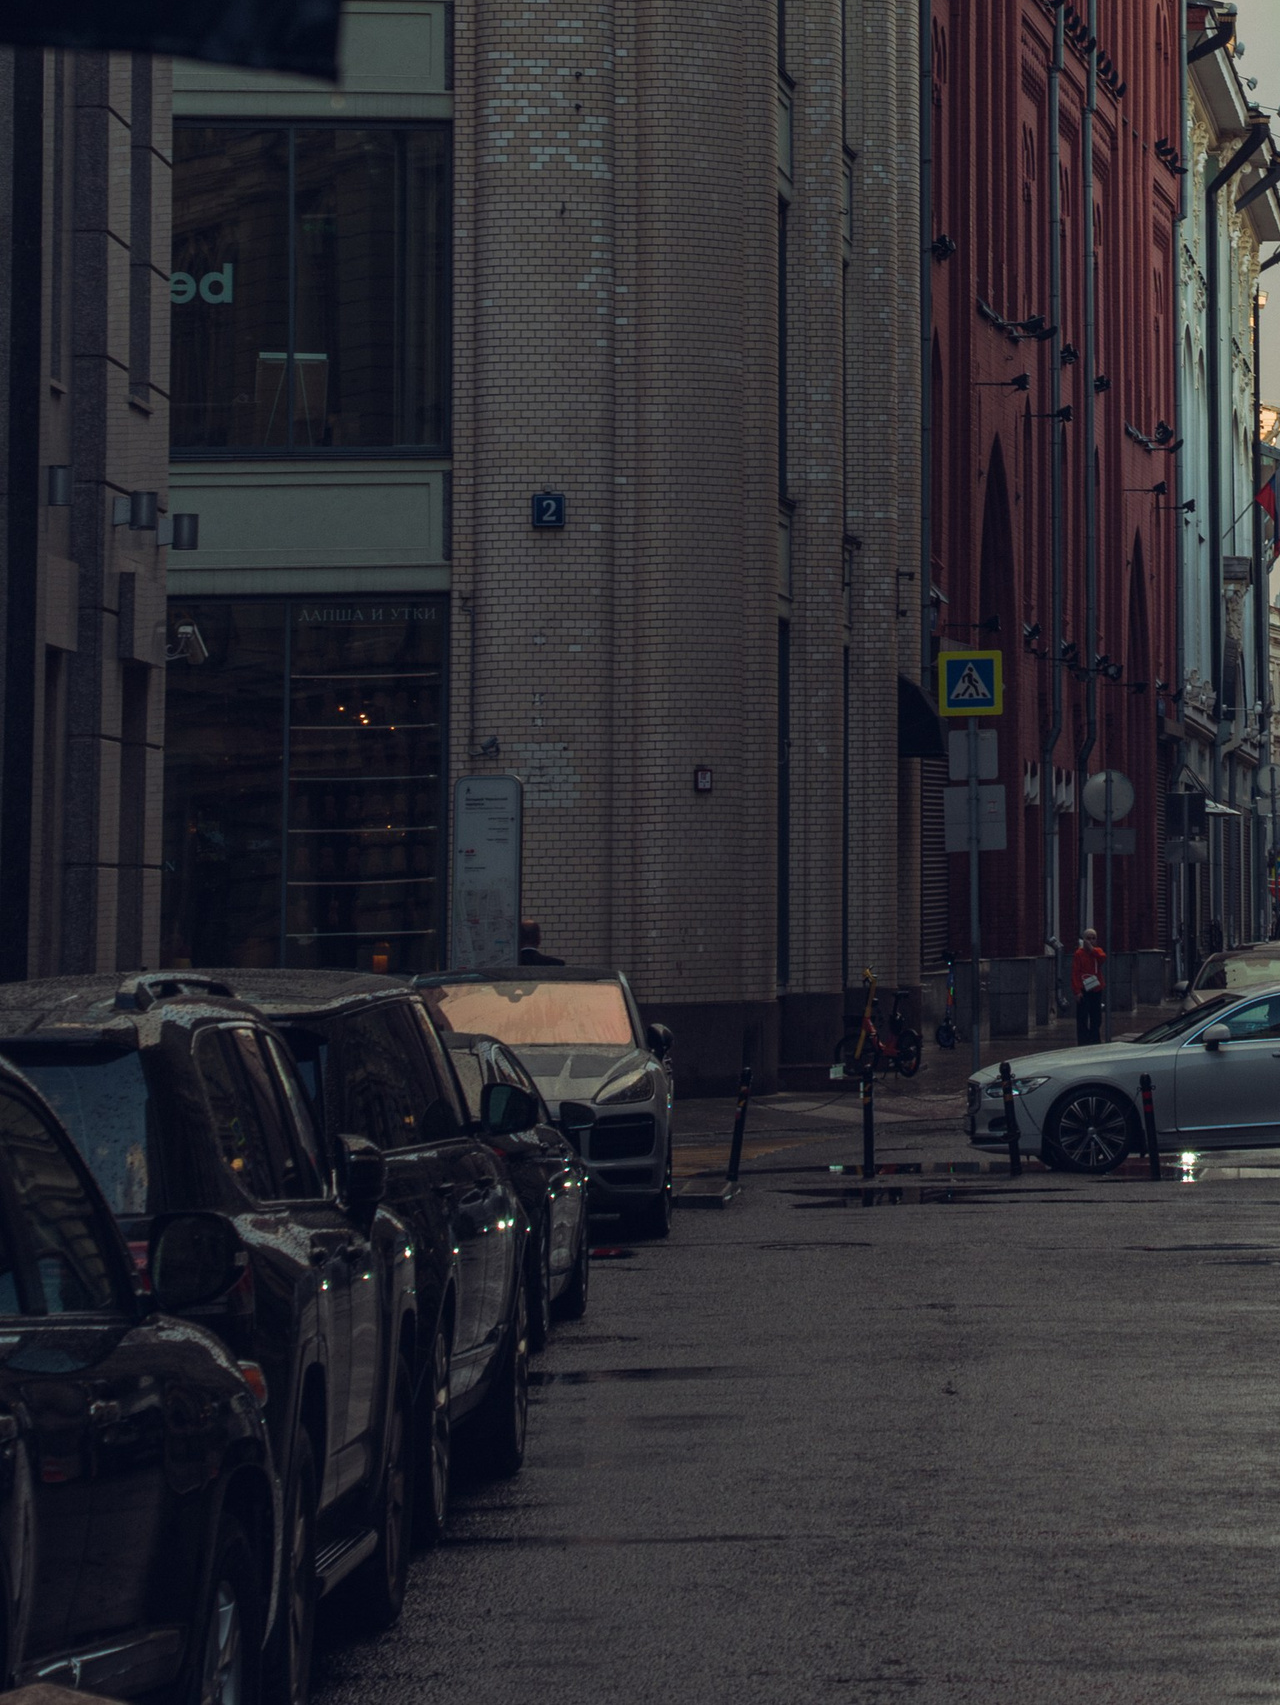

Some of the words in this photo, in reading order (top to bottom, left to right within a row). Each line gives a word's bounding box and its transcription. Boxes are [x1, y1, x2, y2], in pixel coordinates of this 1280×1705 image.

[542, 499, 557, 521] 2
[298, 608, 364, 622] ЛАПША
[371, 608, 385, 621] И
[390, 607, 437, 621] УТКИ
